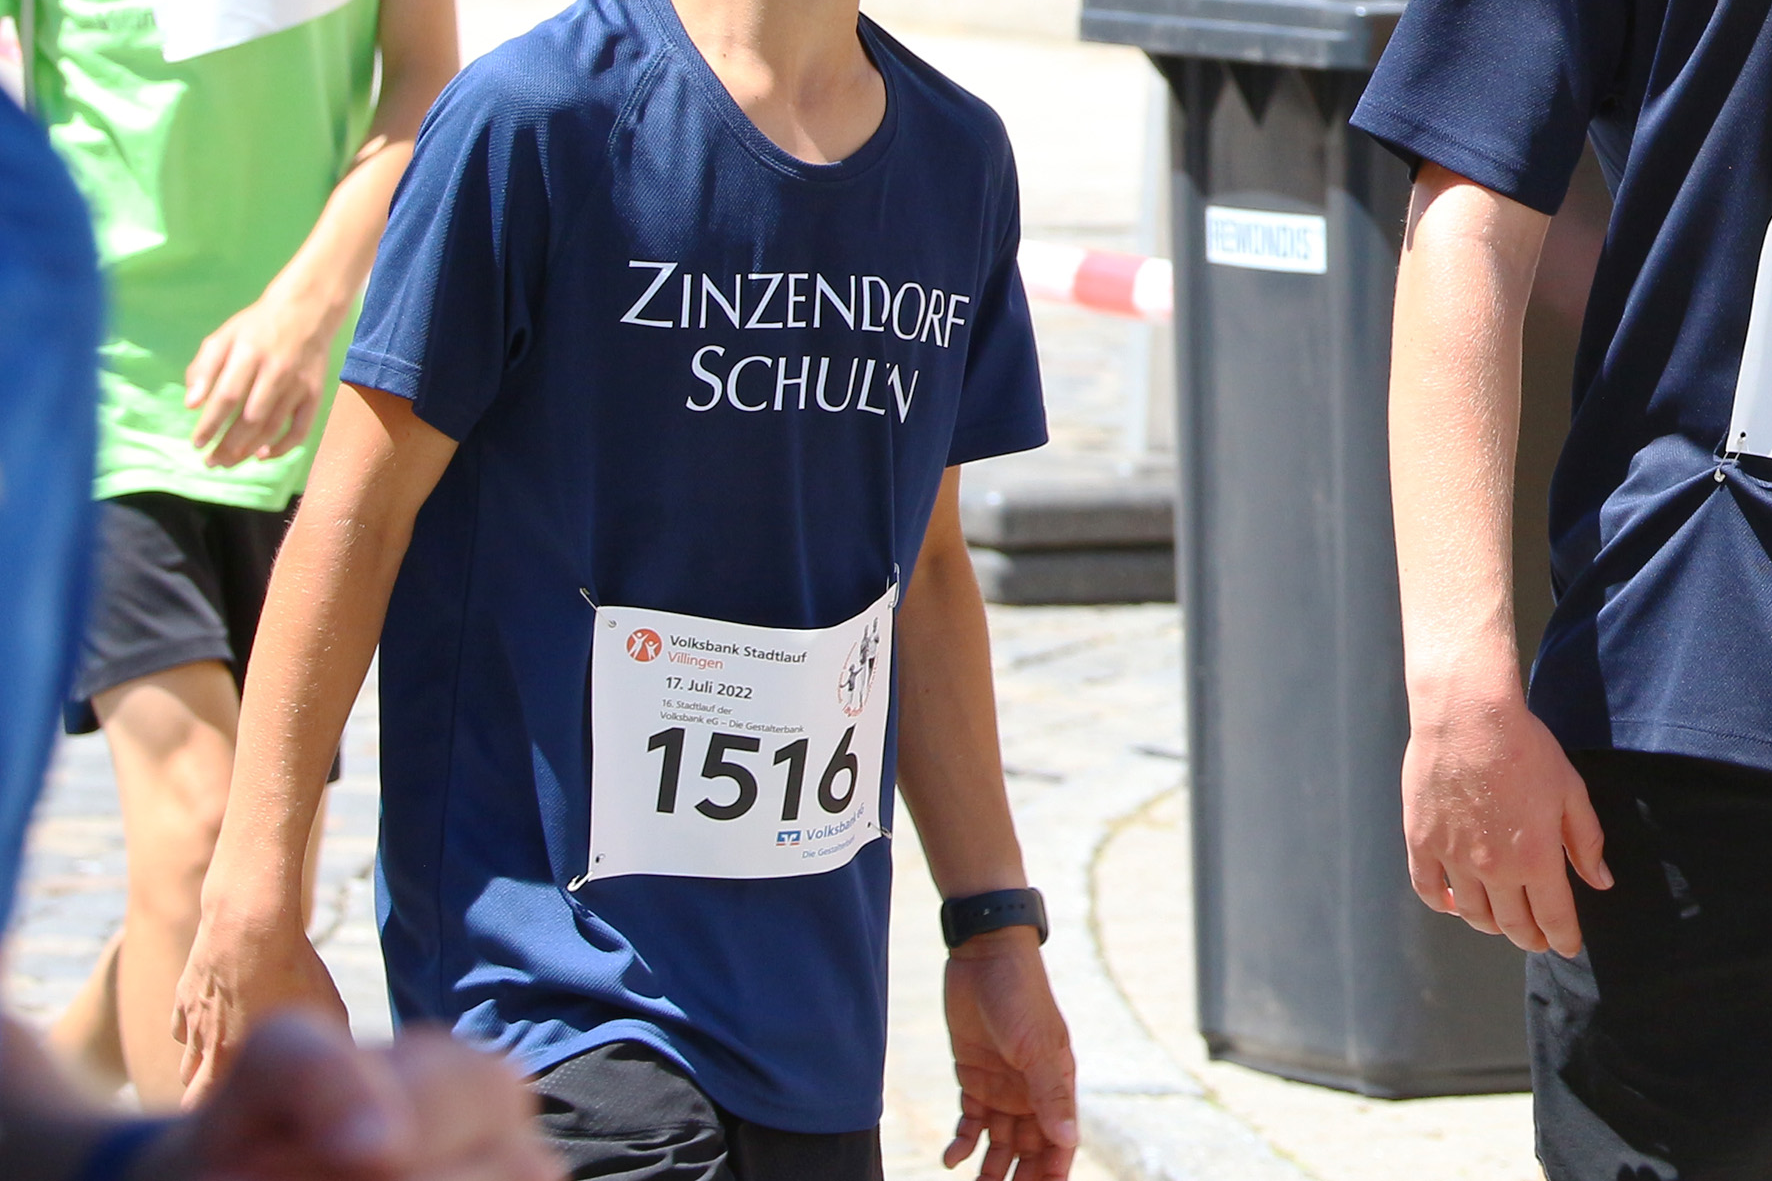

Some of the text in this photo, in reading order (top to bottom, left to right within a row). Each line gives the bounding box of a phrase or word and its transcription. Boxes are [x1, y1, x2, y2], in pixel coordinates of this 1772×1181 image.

[620, 260, 970, 347] ZINZENDORF
[685, 344, 919, 423] SCHULN
[668, 651, 724, 670] Villingen
[670, 635, 808, 663] Volksbank Stadtlauf
[665, 677, 753, 699] 17. Juli 2022
[662, 699, 733, 715] 16. Stadtlauf der
[660, 711, 704, 724] Volksbank
[706, 717, 719, 726] eG
[729, 720, 743, 730] Die
[746, 722, 804, 734] Gestalterbank
[647, 723, 859, 821] 1516
[802, 850, 815, 859] Die
